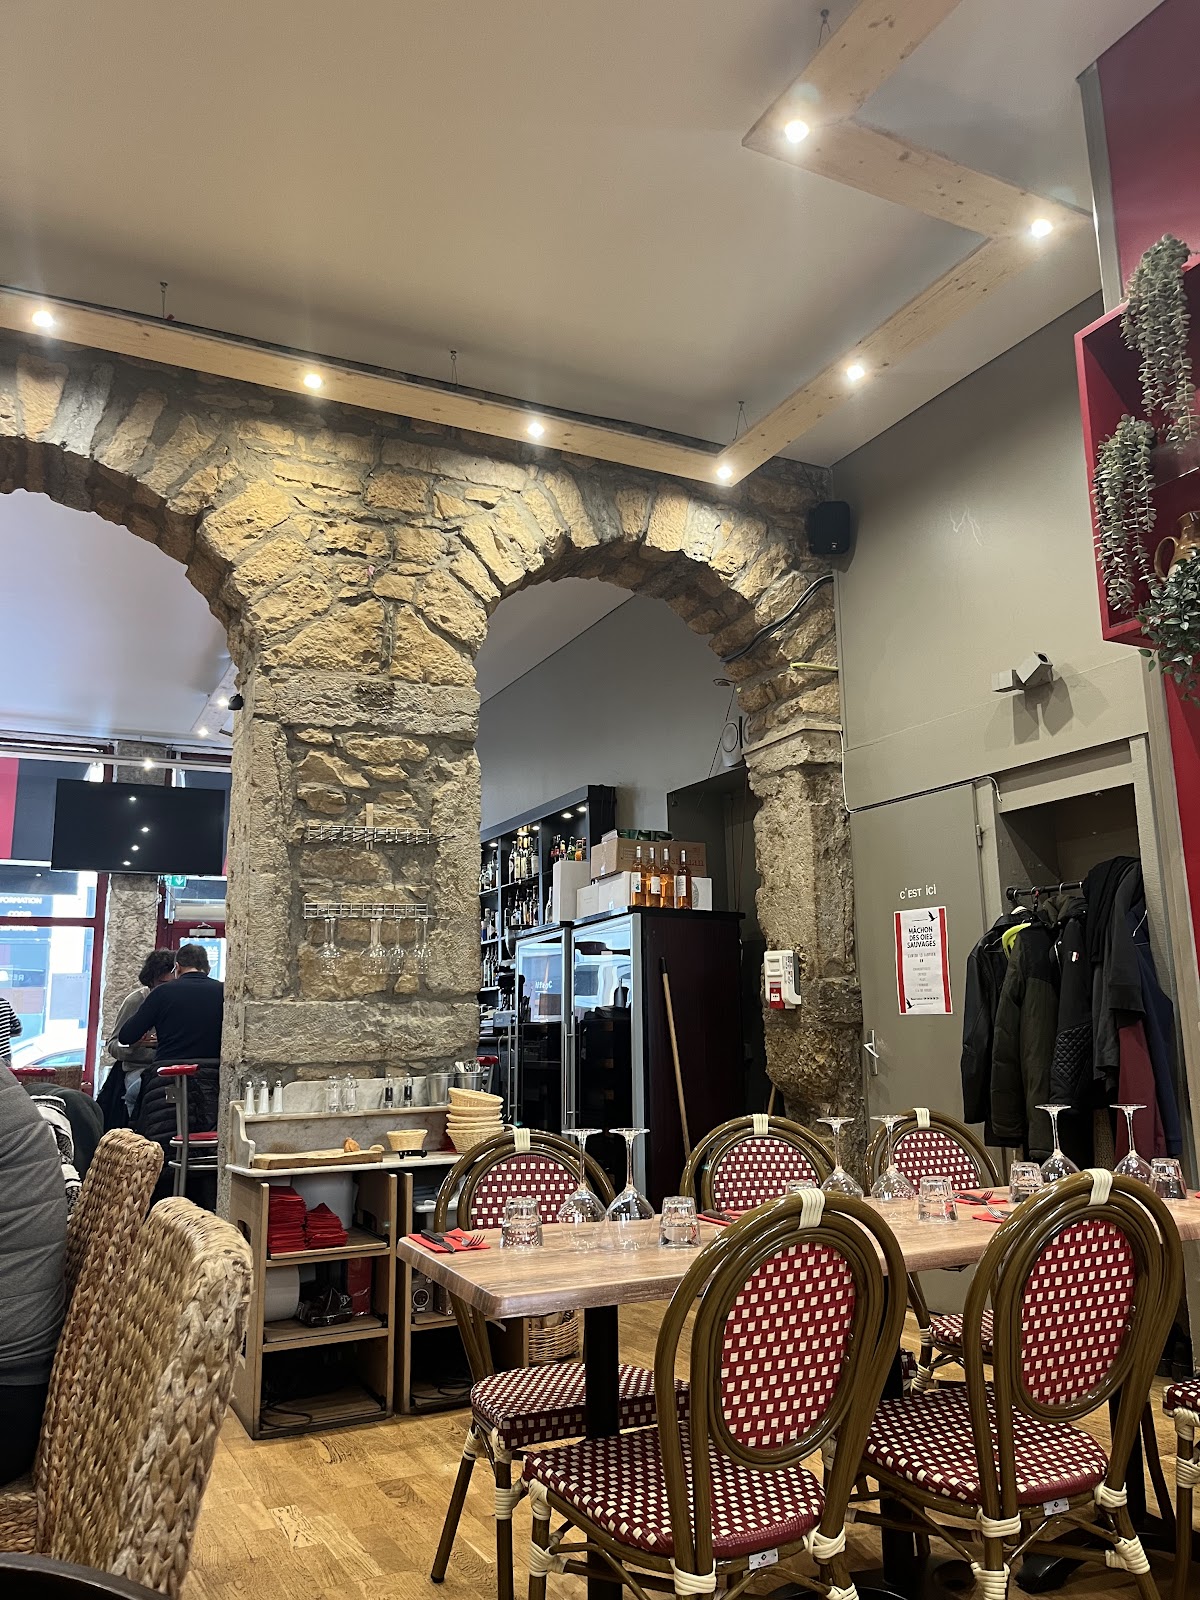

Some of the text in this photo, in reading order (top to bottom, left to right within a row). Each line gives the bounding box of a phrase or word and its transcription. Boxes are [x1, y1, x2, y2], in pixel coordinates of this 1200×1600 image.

[900, 888, 921, 899] C'EST
[908, 926, 933, 934] MÂCHON
[907, 940, 936, 948] SAUVAGES
